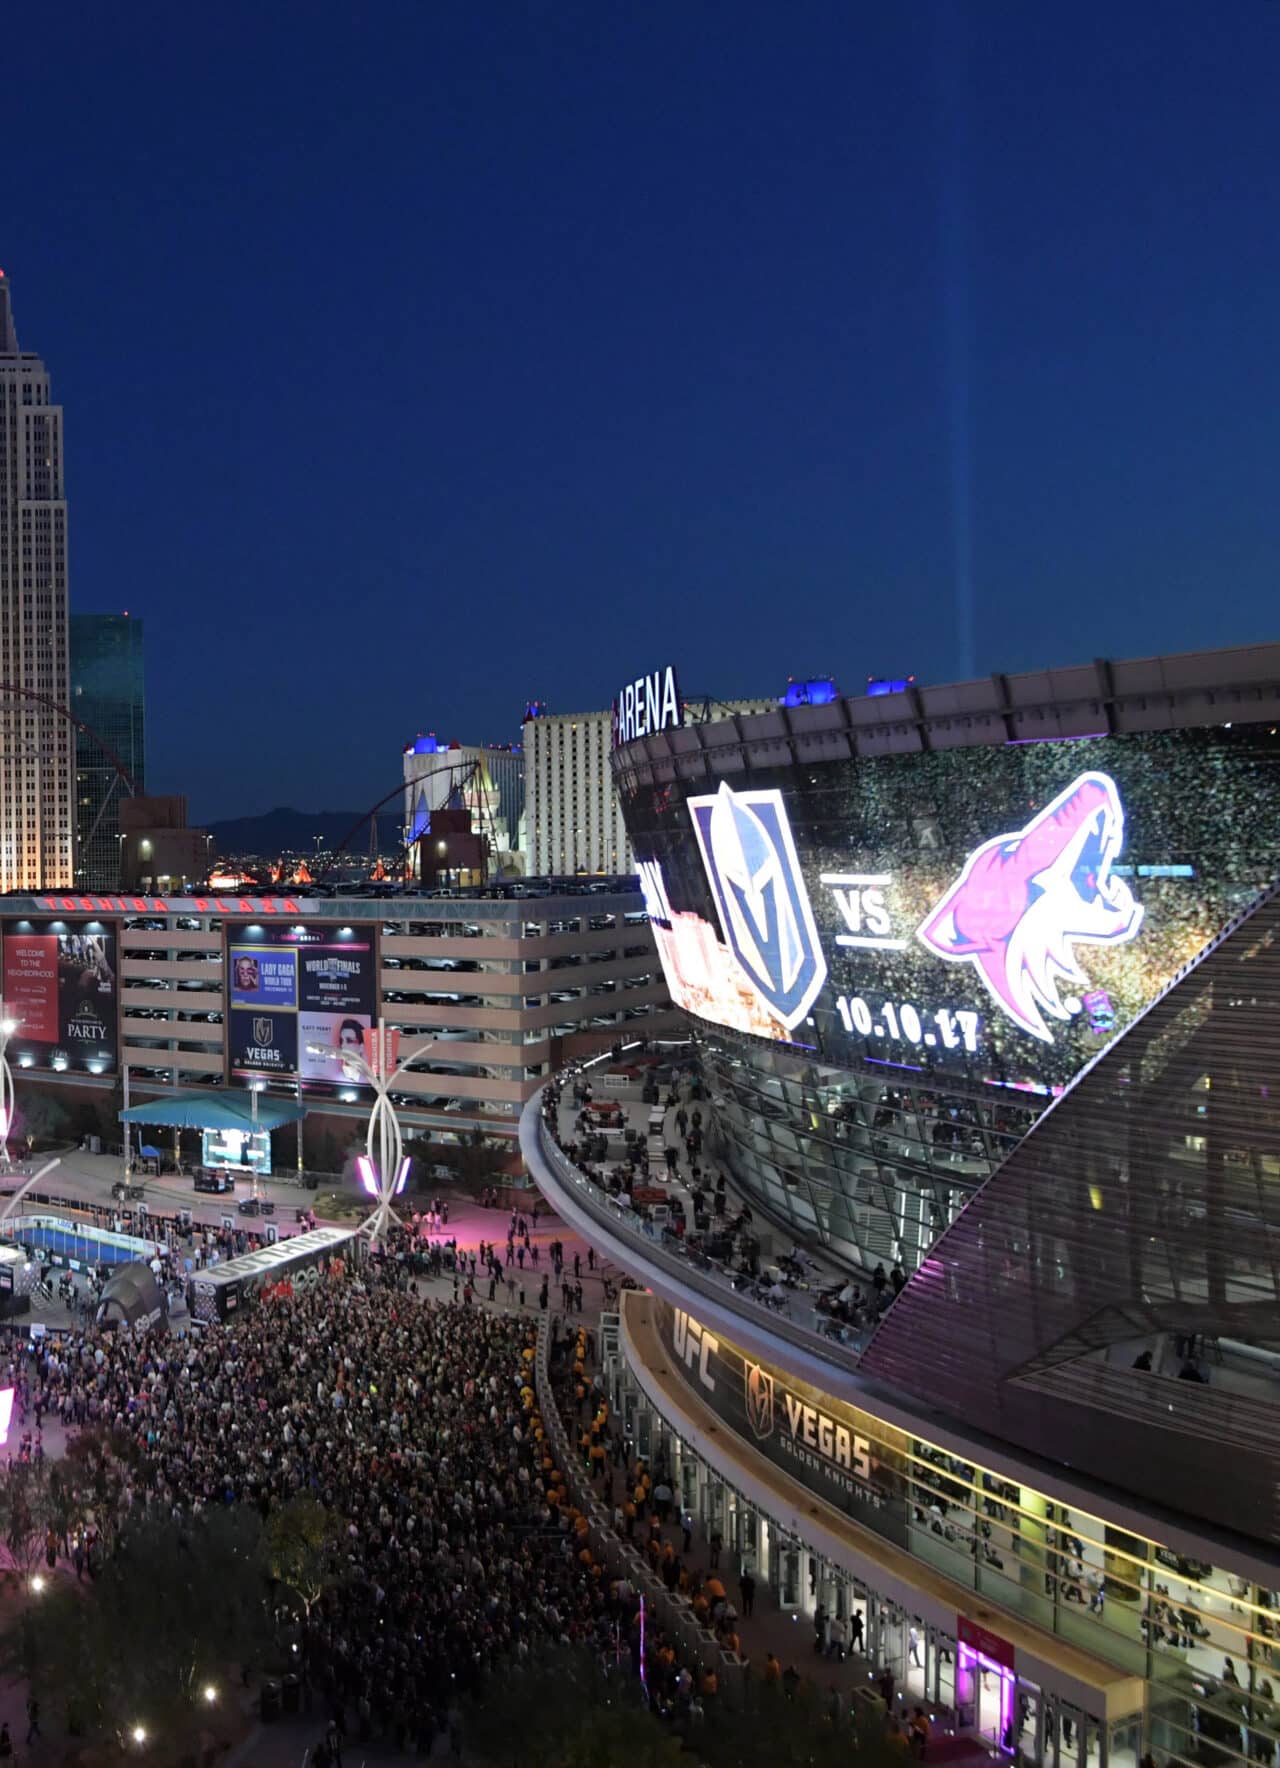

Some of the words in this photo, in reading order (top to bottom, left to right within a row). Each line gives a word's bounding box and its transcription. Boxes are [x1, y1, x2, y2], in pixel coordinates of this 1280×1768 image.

[619, 666, 678, 745] ARENA
[44, 897, 169, 912] TOSHIBA
[195, 898, 301, 913] PLAZA
[832, 889, 891, 934] VS
[16, 949, 45, 957] WELCOME
[20, 959, 28, 967] TO
[30, 959, 40, 968] THE
[261, 963, 276, 976] LADY
[278, 964, 294, 977] GAGA
[305, 959, 329, 972] WORLD
[336, 960, 360, 974] FINALS
[68, 1023, 107, 1039] PARTY
[247, 1047, 280, 1061] VEGAS
[674, 1307, 719, 1392] UFC
[785, 1393, 870, 1479] VEGAS
[779, 1436, 820, 1470] GOLDEN
[824, 1467, 881, 1509] KNIGHTS
